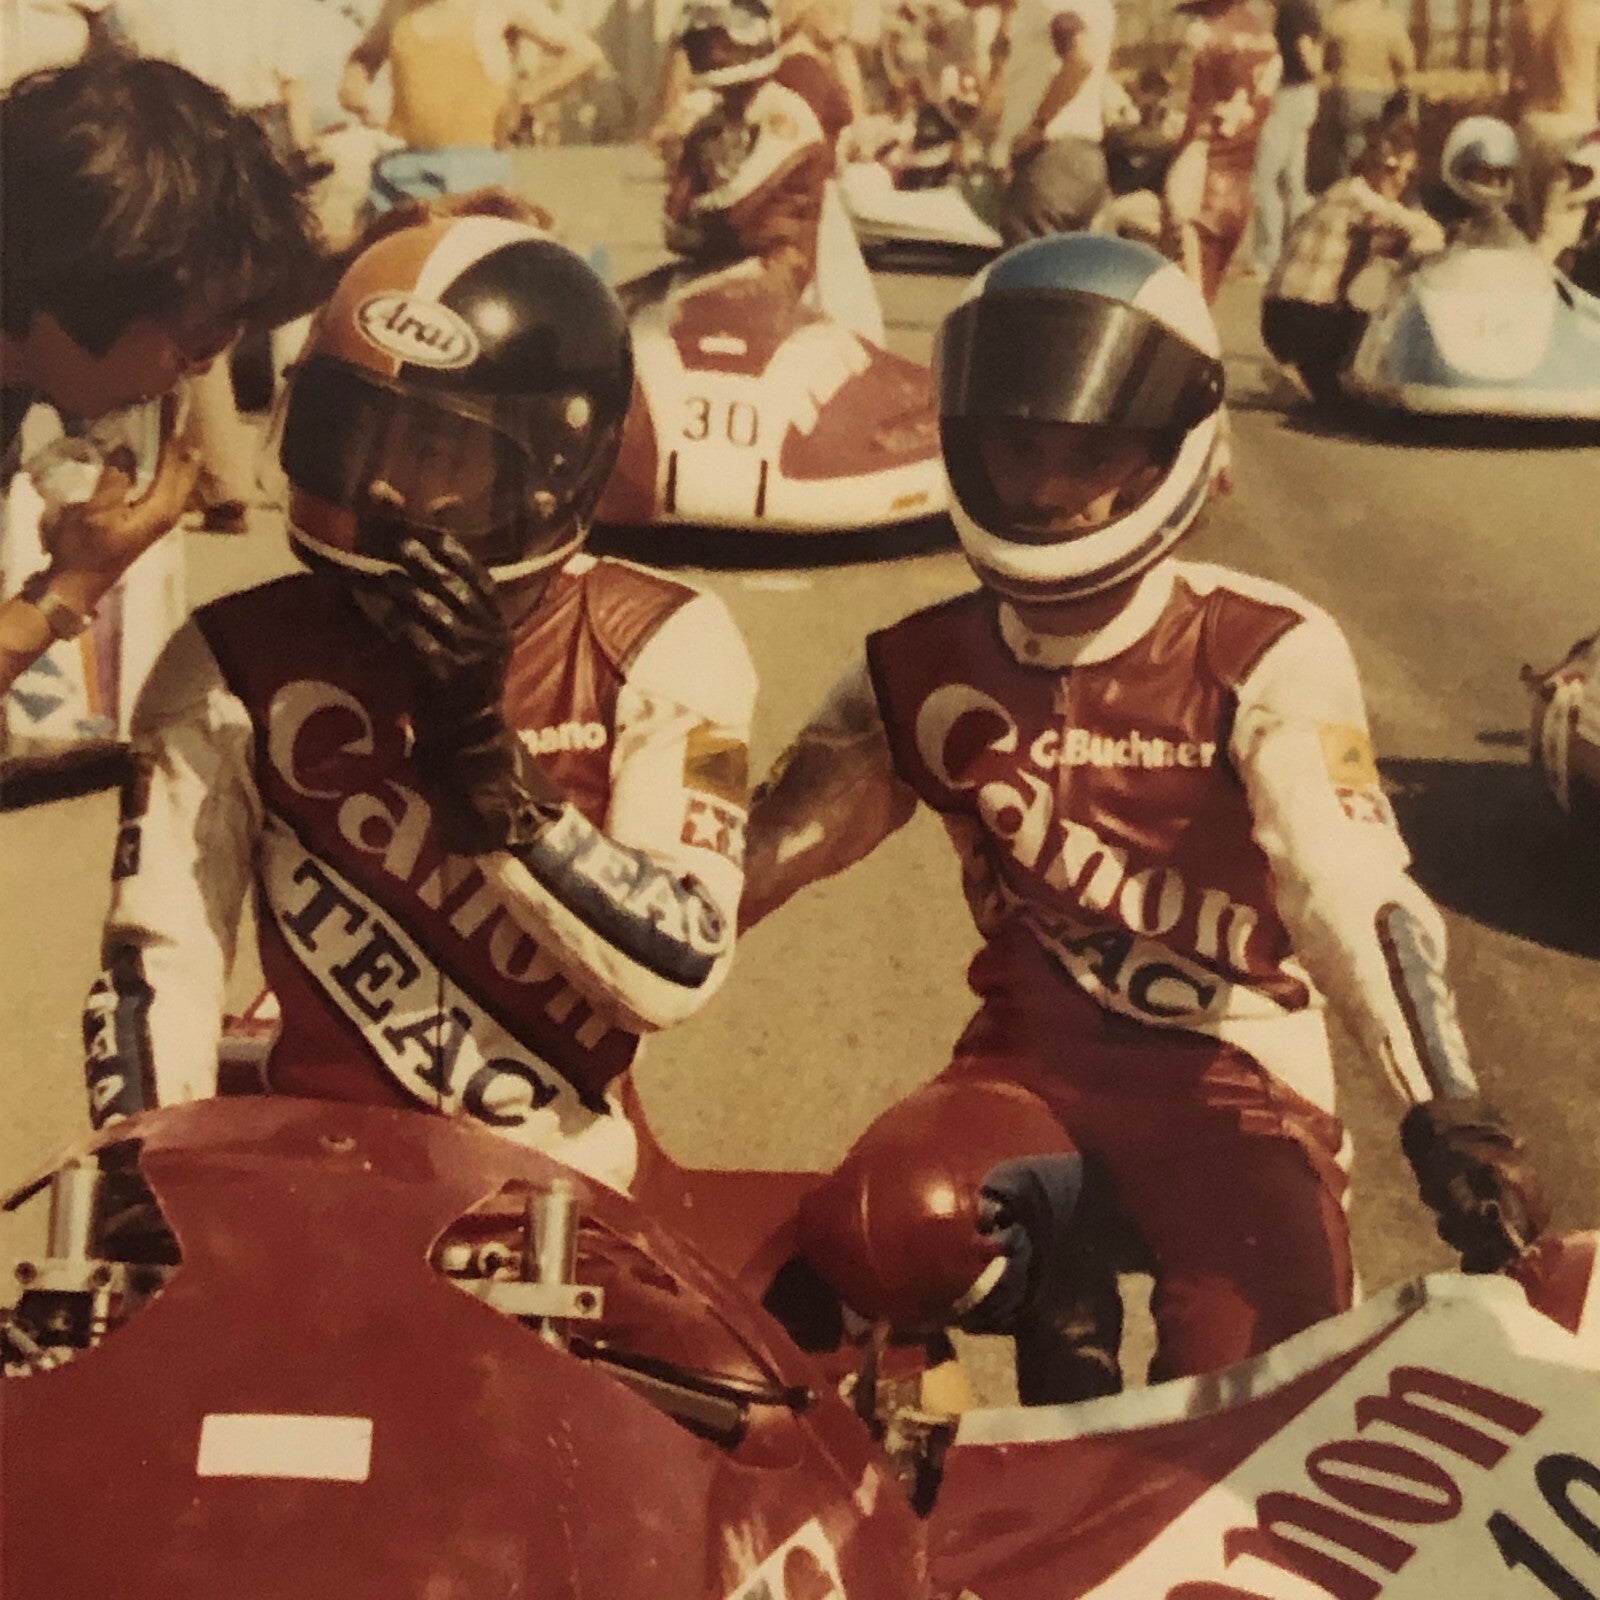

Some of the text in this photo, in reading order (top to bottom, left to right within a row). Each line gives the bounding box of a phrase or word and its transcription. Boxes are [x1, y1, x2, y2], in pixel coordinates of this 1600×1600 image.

[682, 396, 758, 447] 30
[915, 682, 1259, 974] Canon
[282, 857, 560, 1127] TEAC
[1040, 910, 1218, 1018] AC
